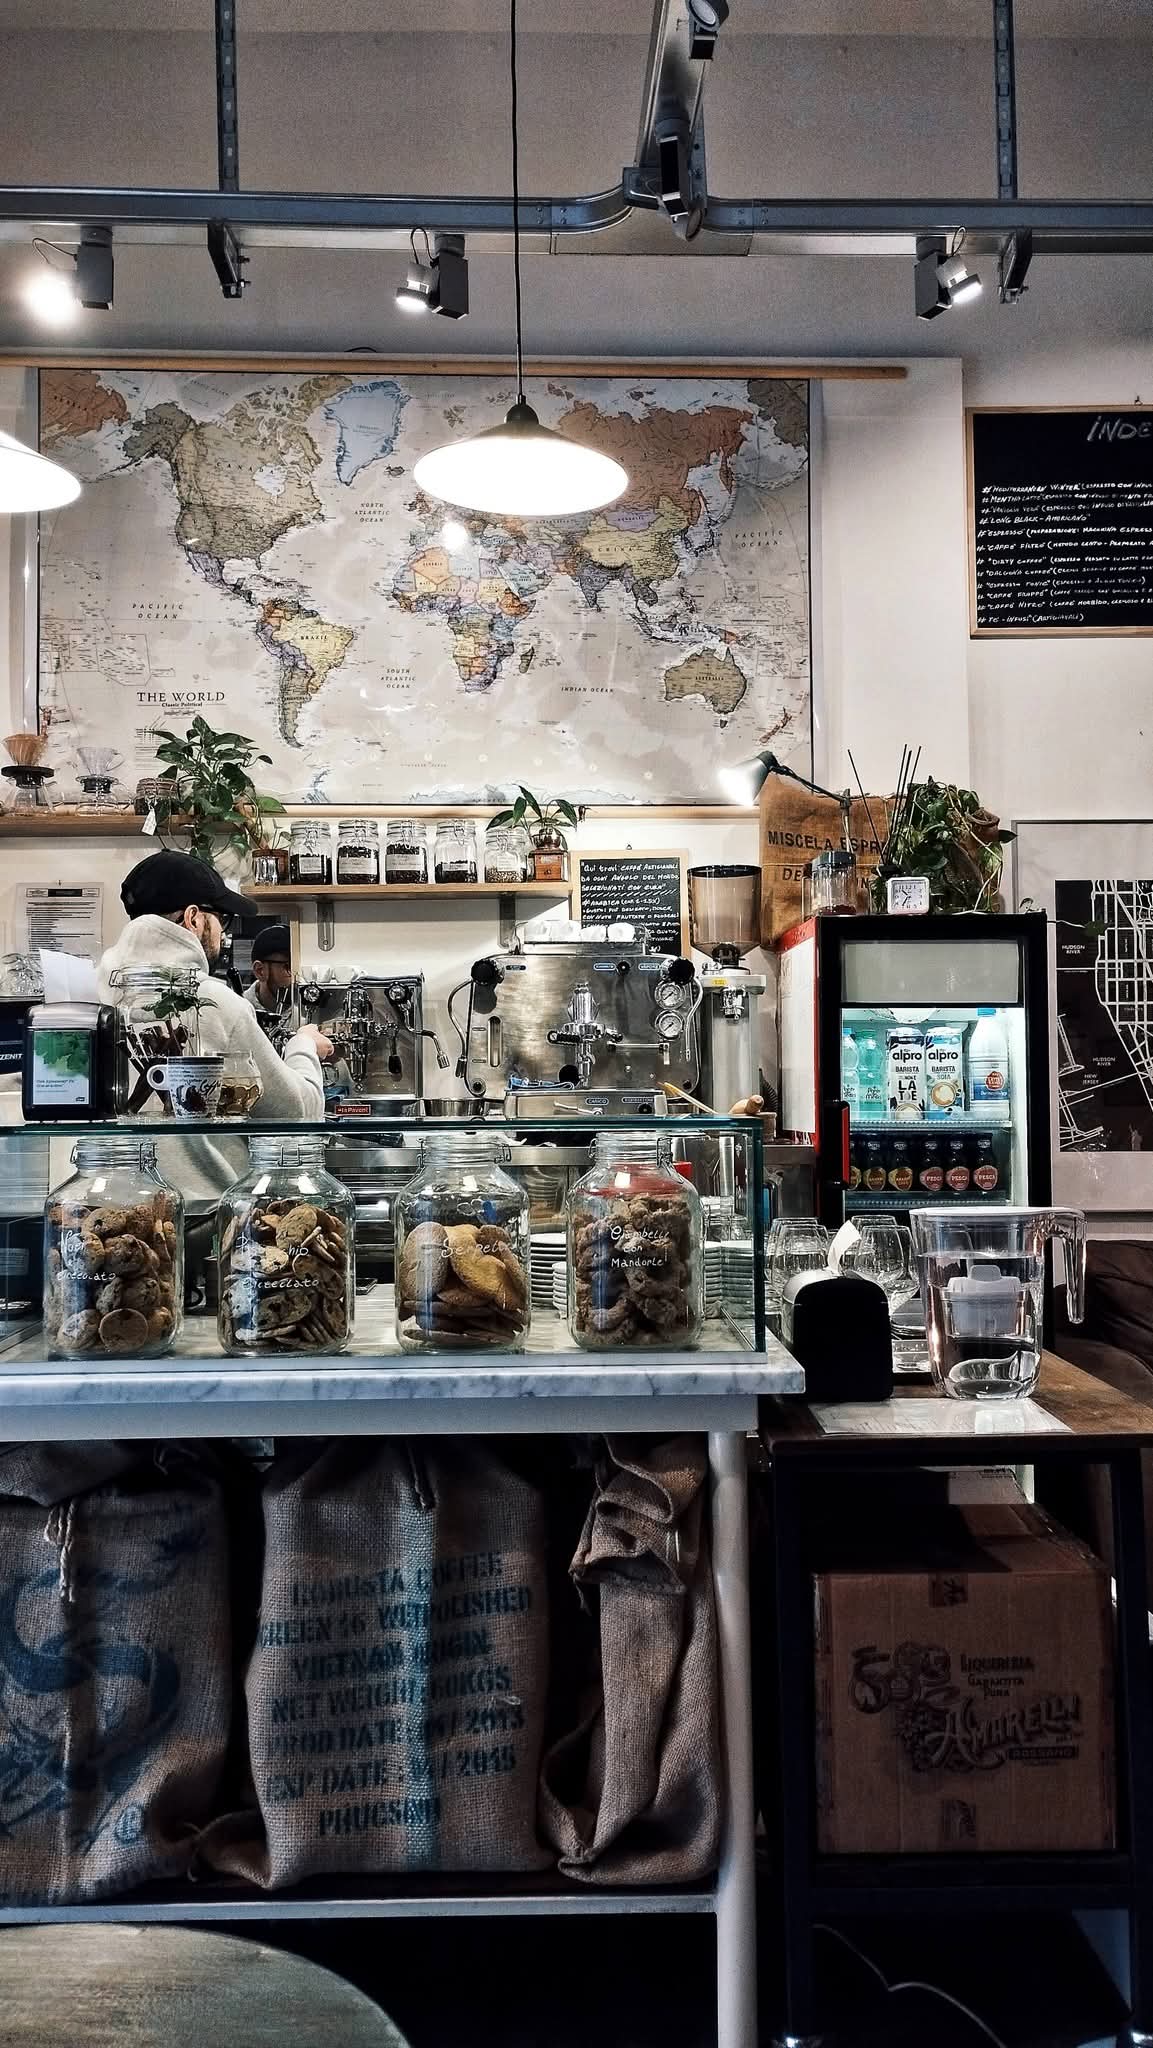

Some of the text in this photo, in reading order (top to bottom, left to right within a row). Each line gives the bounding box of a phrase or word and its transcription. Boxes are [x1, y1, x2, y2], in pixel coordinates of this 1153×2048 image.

[735, 530, 782, 538] PACIFIC
[136, 691, 226, 702] THE WORLD
[768, 831, 834, 851] MISCELA
[892, 1049, 922, 1063] alpro
[928, 1049, 959, 1062] alpro
[291, 1640, 403, 1681] VIETNAM
[271, 1692, 321, 1724] NET
